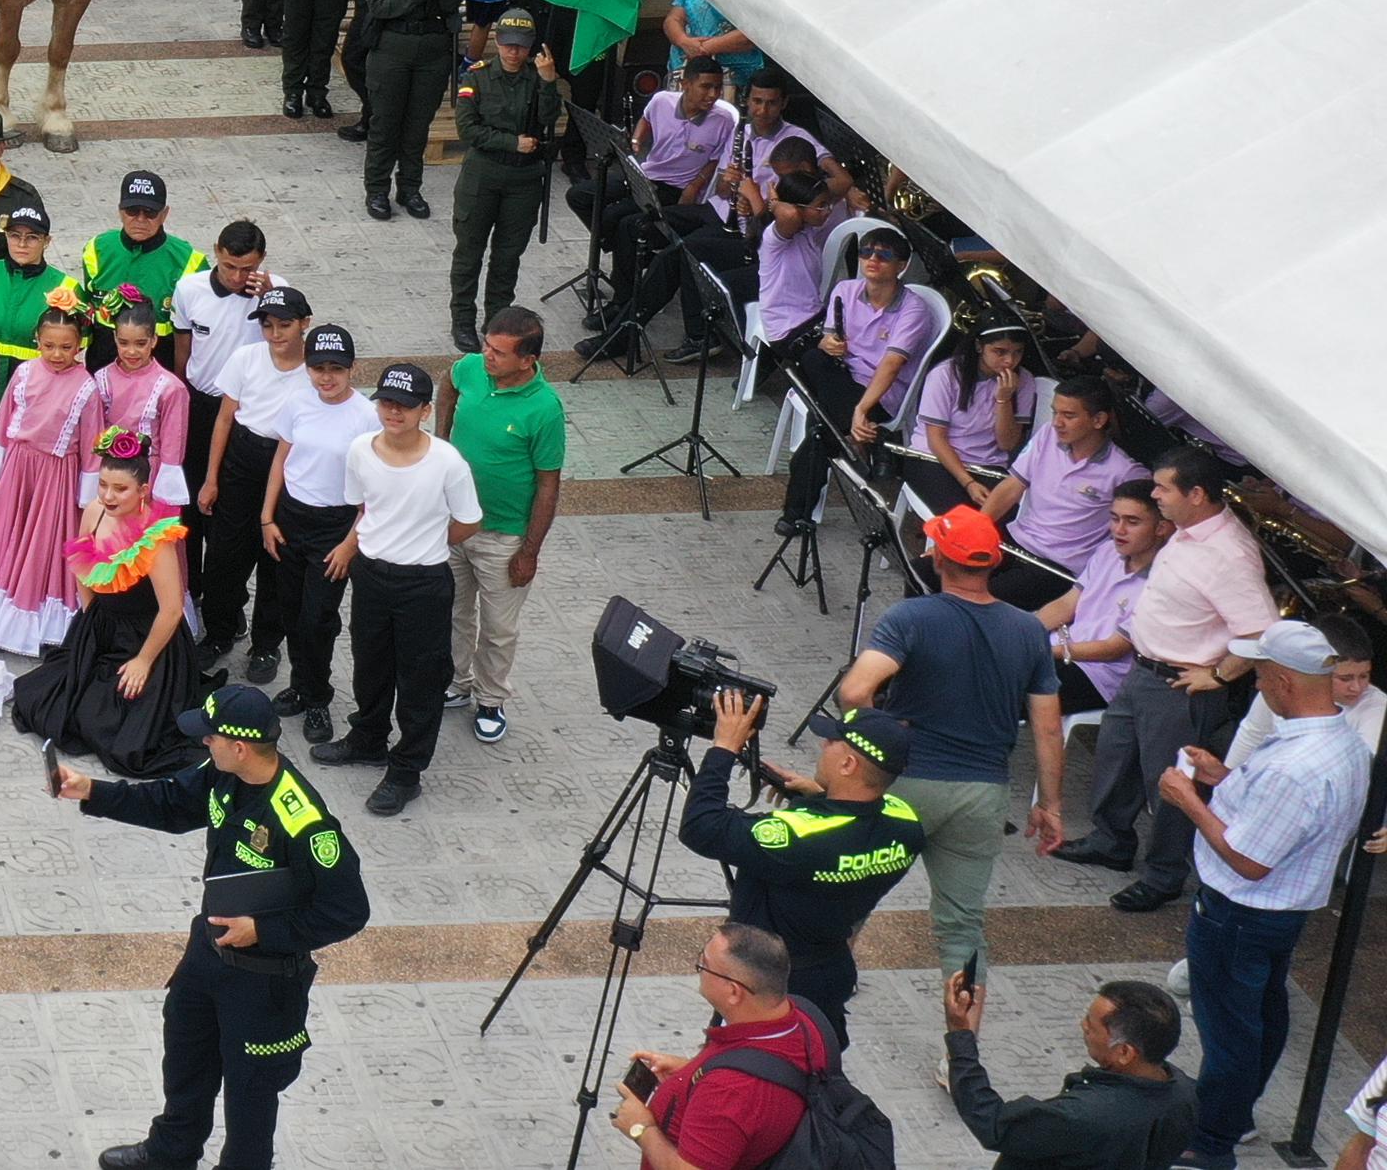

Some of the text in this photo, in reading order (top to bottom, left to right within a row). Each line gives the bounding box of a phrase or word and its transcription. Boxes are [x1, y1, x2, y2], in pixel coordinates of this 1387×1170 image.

[129, 184, 155, 196] CIVICA
[317, 332, 342, 342] CIVICA
[387, 370, 413, 381] CIVICA
[838, 840, 906, 872] POLICÍA
